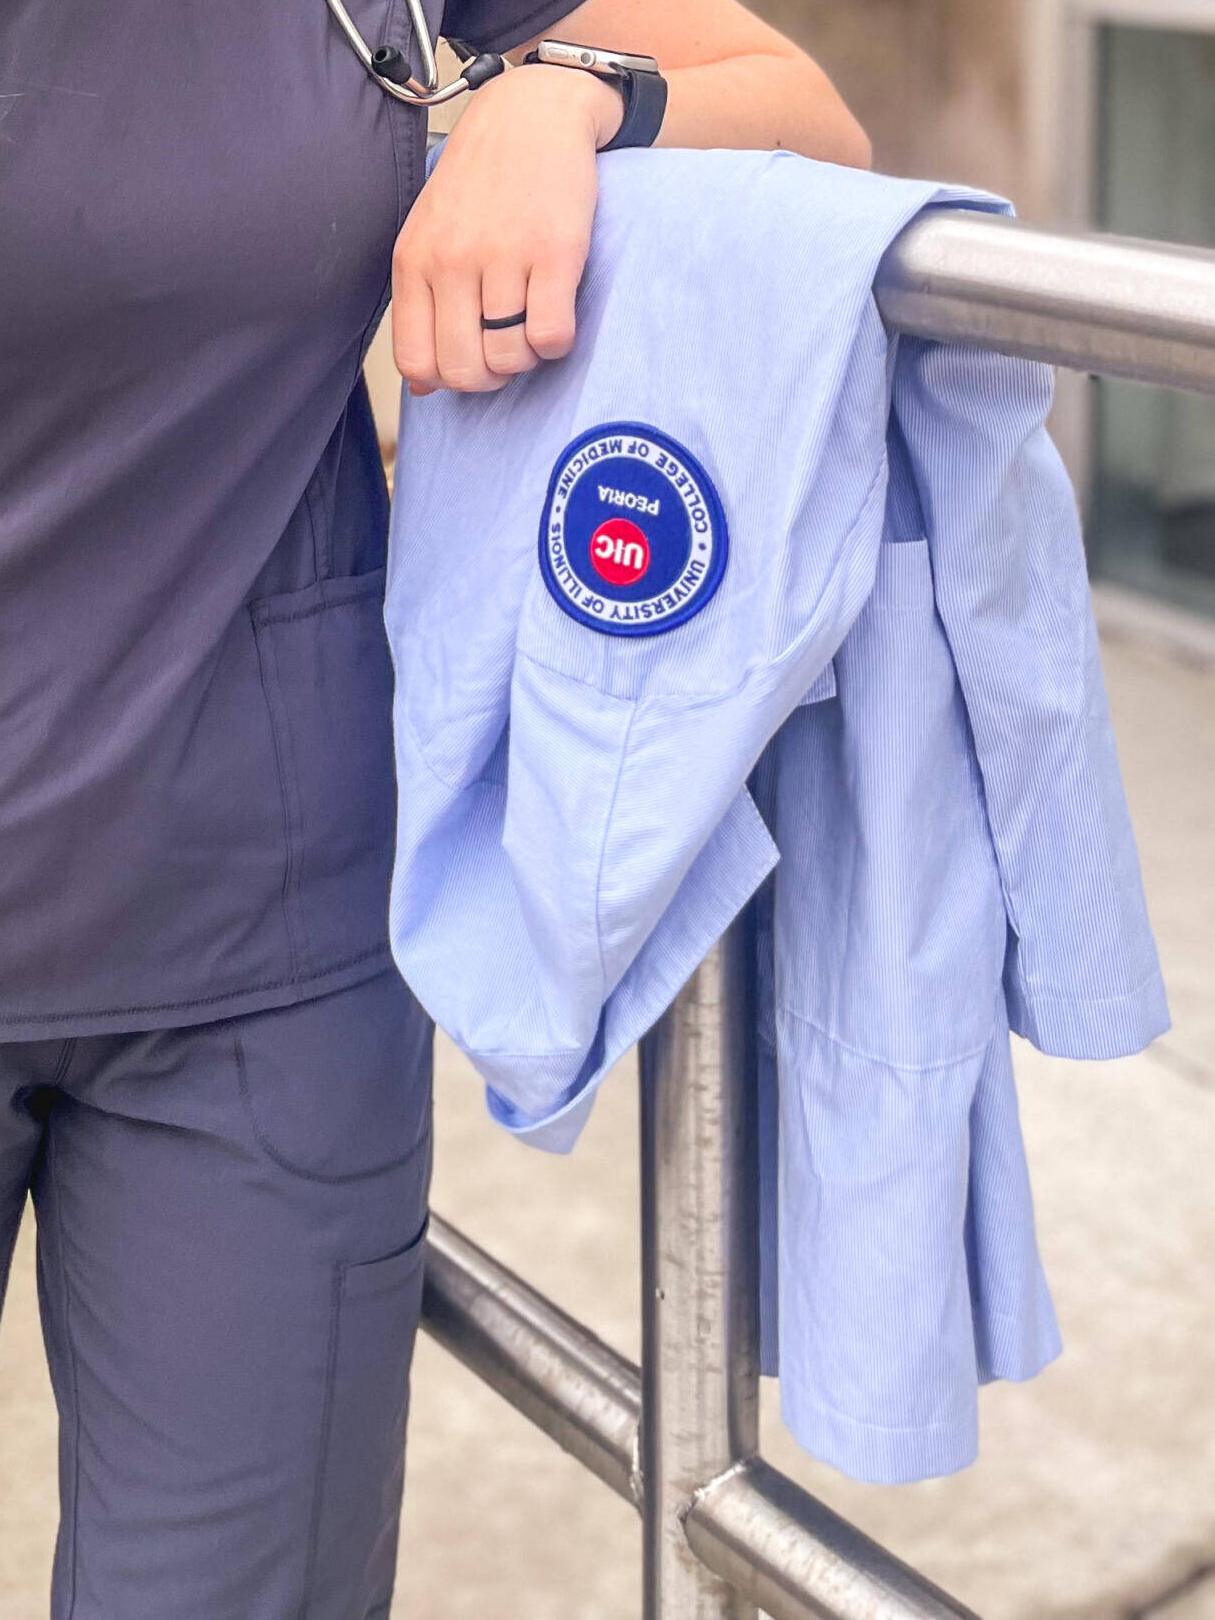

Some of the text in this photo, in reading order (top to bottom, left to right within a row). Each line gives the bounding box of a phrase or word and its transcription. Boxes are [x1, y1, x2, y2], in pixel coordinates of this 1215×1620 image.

[558, 439, 708, 534] COLLEGE OF MEDICINE
[597, 485, 660, 516] PEORIA
[551, 522, 706, 621] UNIVERSITY OF ILLINOIS
[594, 534, 644, 570] UIC
